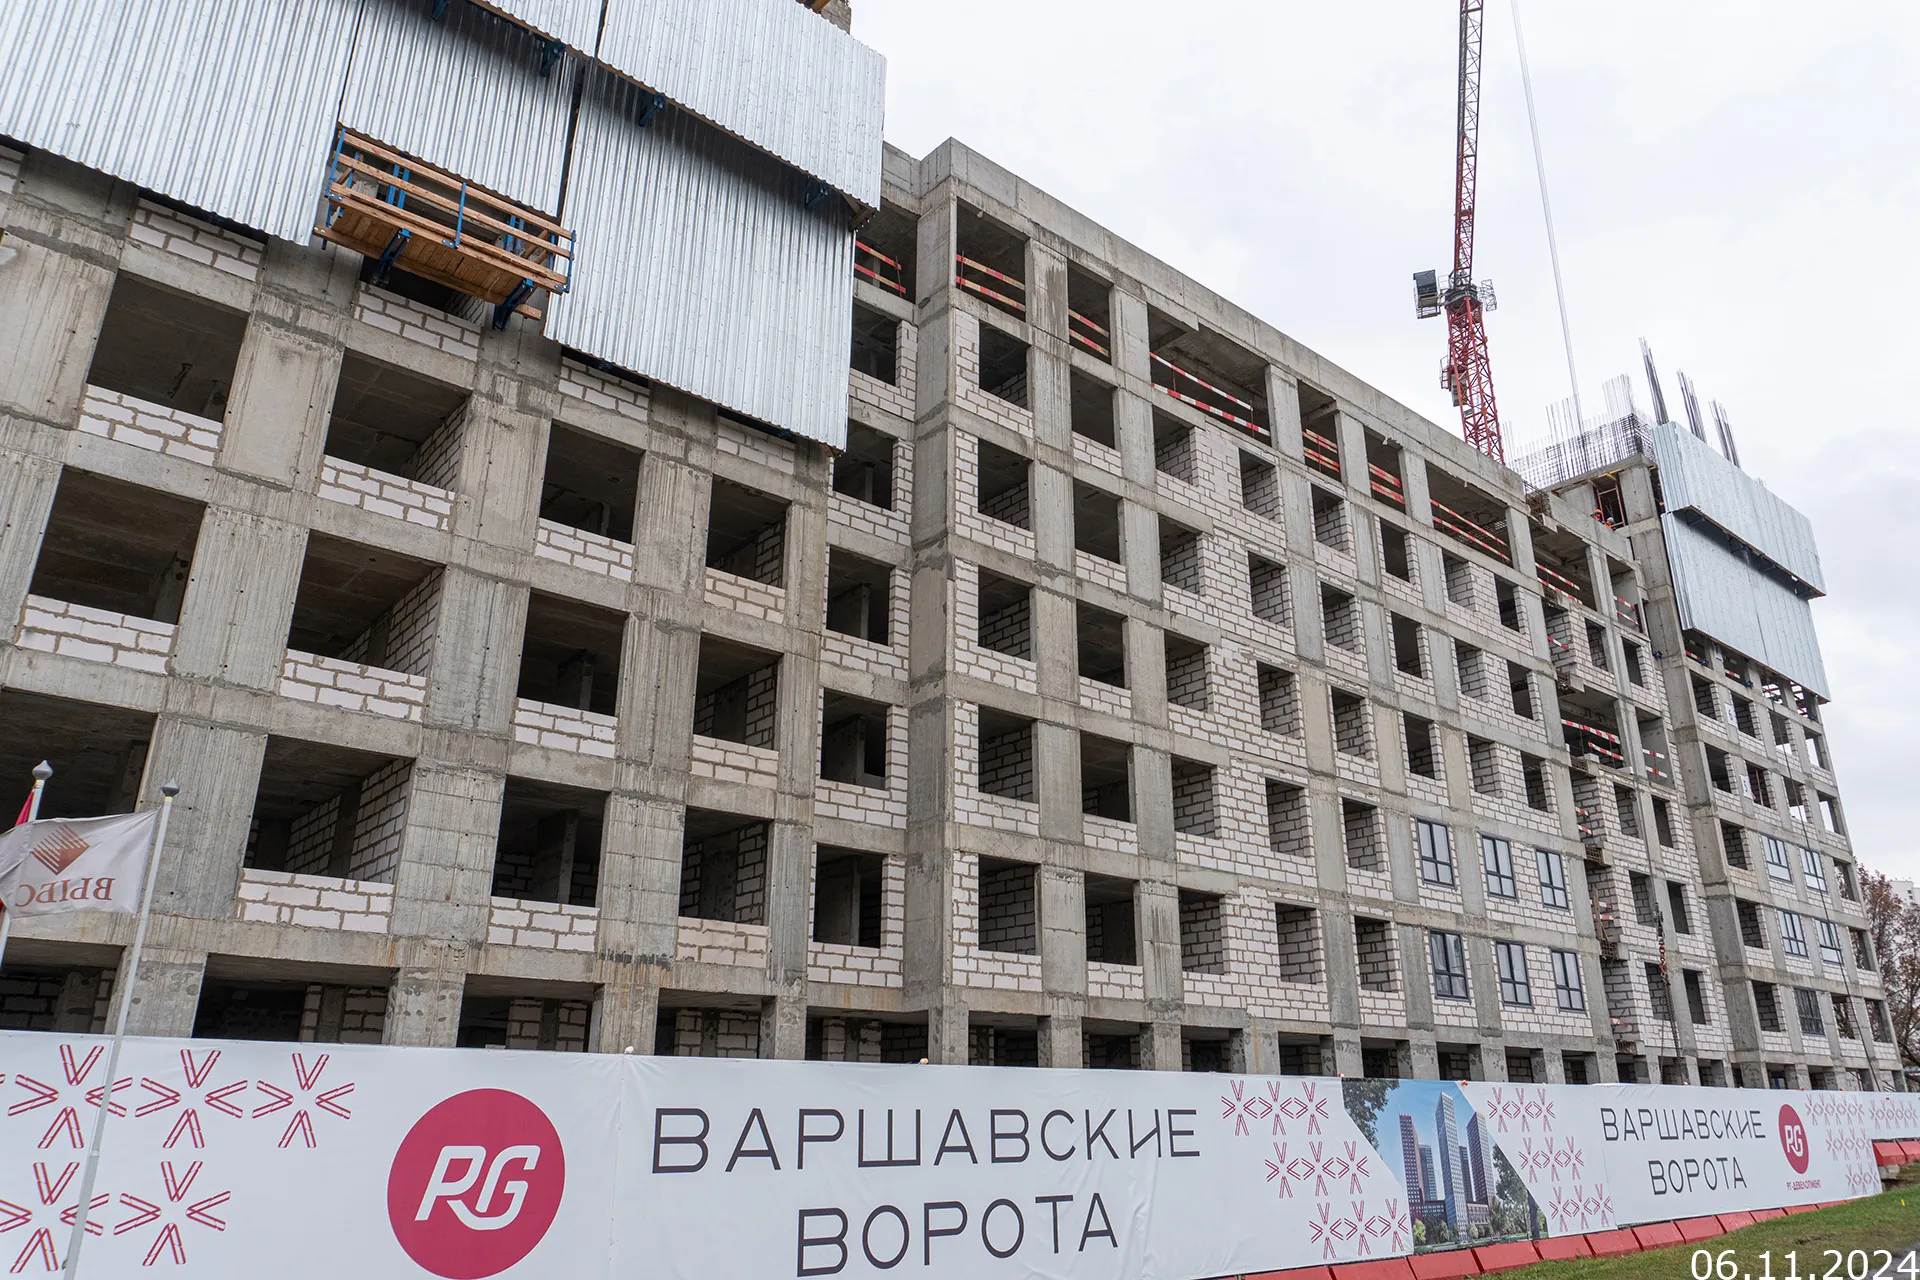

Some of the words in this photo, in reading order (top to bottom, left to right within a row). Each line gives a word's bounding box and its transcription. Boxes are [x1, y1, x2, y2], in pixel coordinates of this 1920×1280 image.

[652, 1107, 1200, 1174] ВАРШАВСКИЕ
[1600, 1107, 1766, 1141] ВАРШАВСКИЕ
[414, 1145, 541, 1231] RG
[1648, 1157, 1747, 1195] ВОРОТА
[797, 1192, 1118, 1277] ВОРОТА
